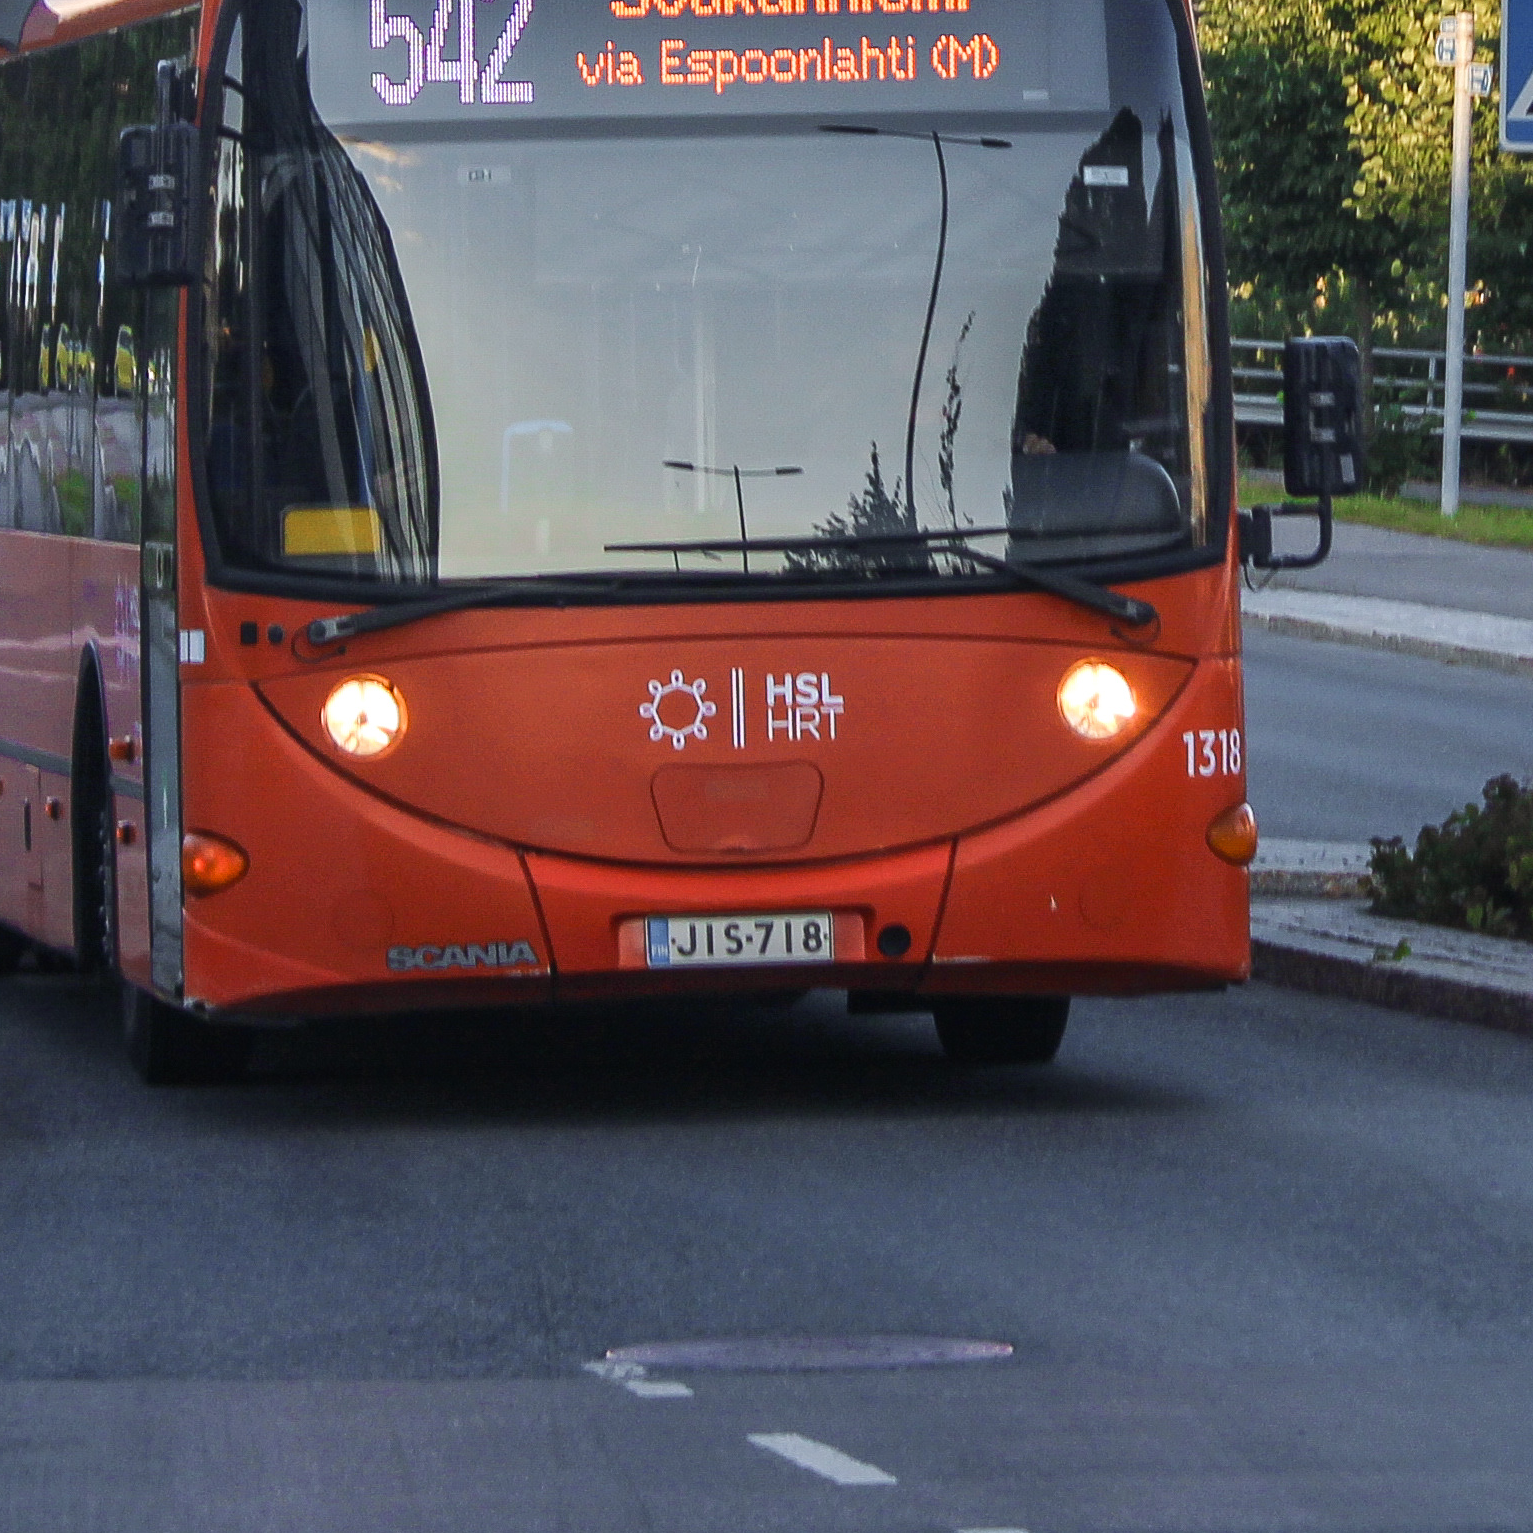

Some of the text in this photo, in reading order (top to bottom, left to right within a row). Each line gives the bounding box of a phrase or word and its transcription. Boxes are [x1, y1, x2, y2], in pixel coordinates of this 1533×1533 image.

[576, 33, 1000, 95] via Espoonlahti (M)
[766, 672, 844, 707] HSL
[767, 705, 844, 742] HRT
[1183, 728, 1241, 778] 1318
[387, 939, 539, 971] SCANIA
[677, 919, 823, 957] JIS-718
